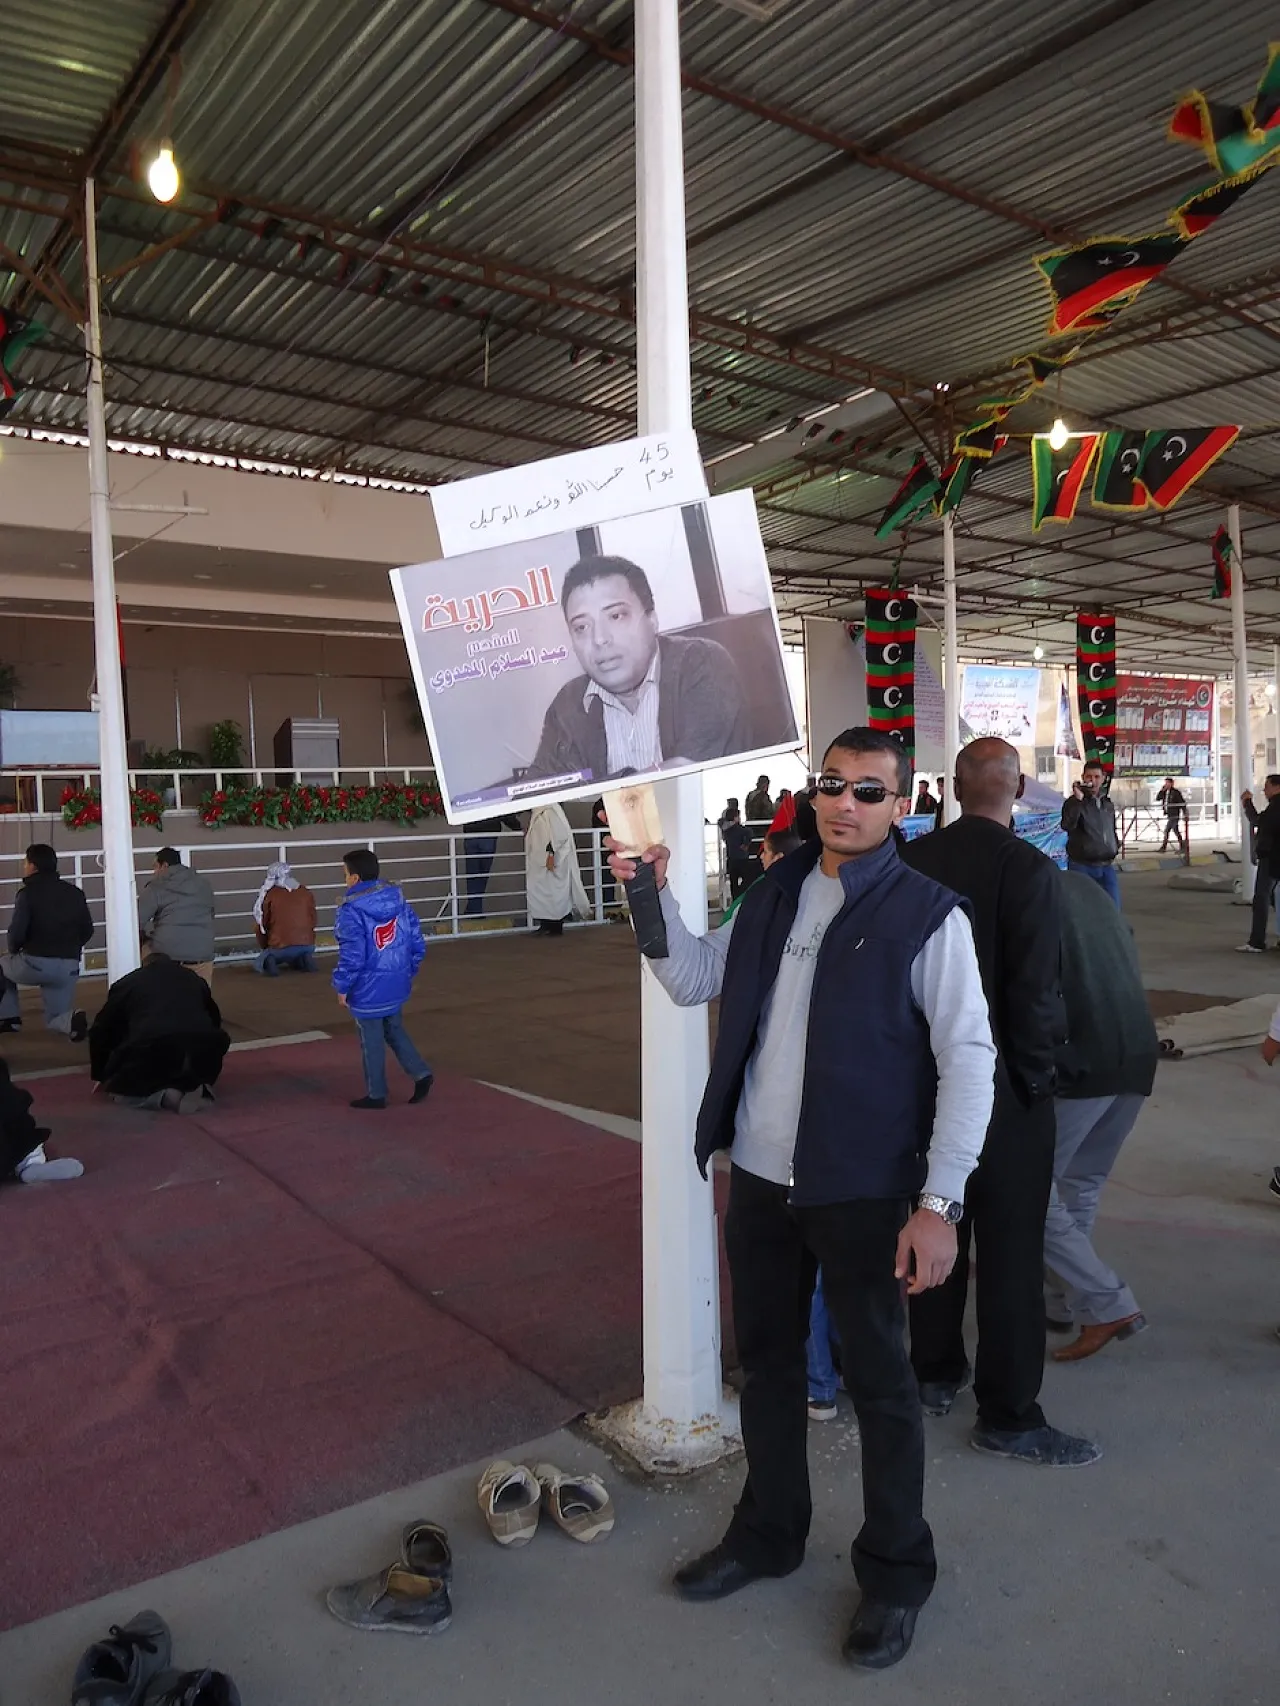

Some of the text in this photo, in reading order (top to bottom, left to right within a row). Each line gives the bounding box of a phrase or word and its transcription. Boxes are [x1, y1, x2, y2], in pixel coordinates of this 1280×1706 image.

[639, 442, 670, 465] 45
[644, 467, 675, 491] يوم
[423, 565, 558, 633] الحرية
[488, 647, 537, 680] السلام
[538, 645, 569, 664] عبد
